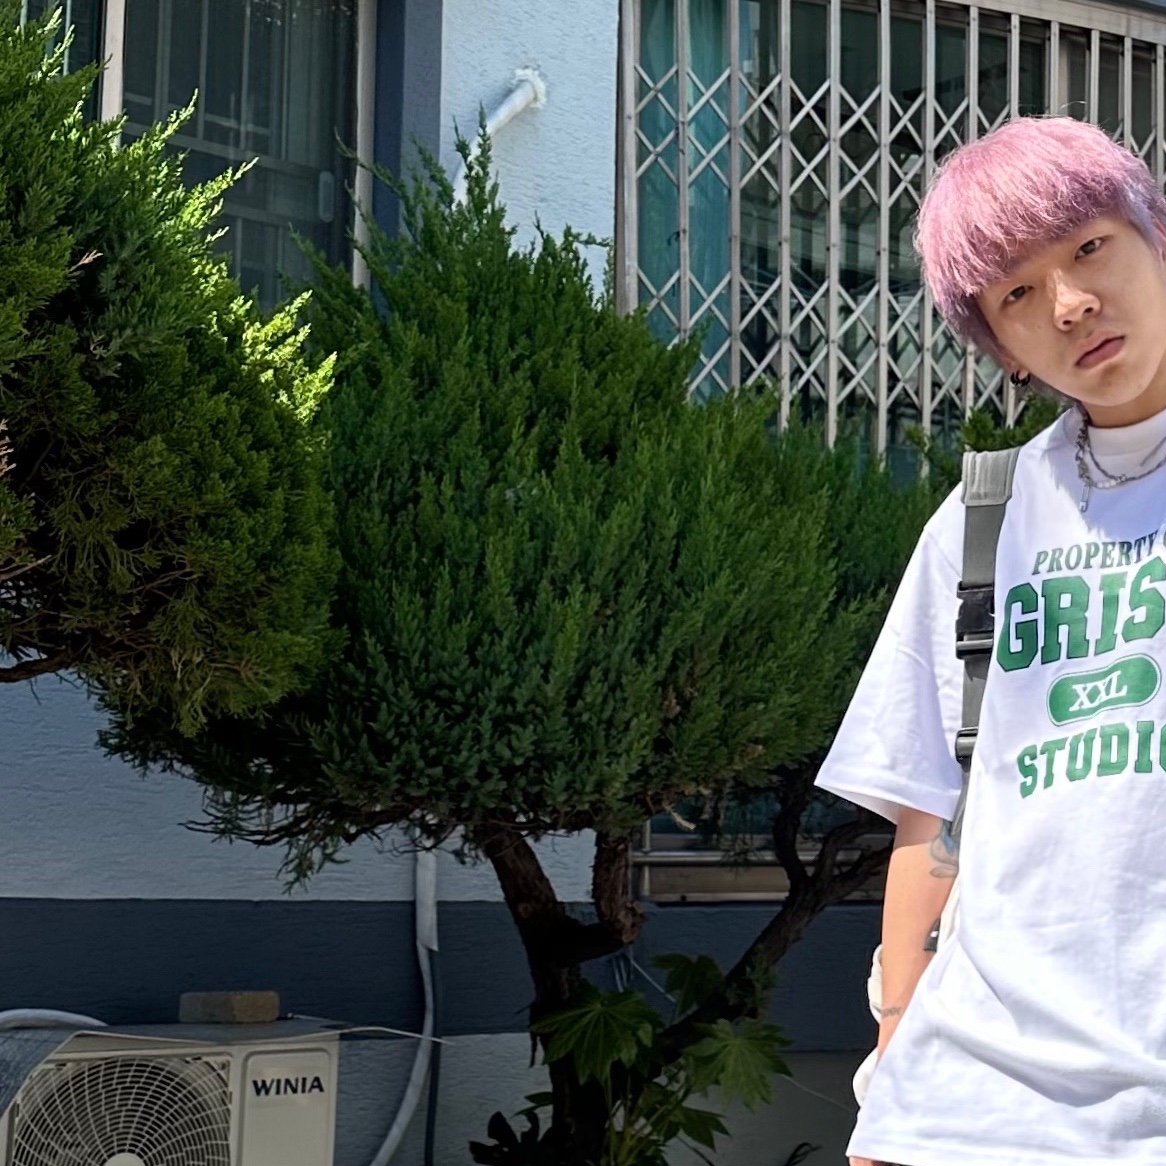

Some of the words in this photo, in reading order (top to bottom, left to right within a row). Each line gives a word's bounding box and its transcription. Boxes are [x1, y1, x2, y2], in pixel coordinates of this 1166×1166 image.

[1032, 531, 1158, 575] PROPERTY
[1069, 671, 1128, 712] XXL
[252, 1076, 325, 1097] WINIA
